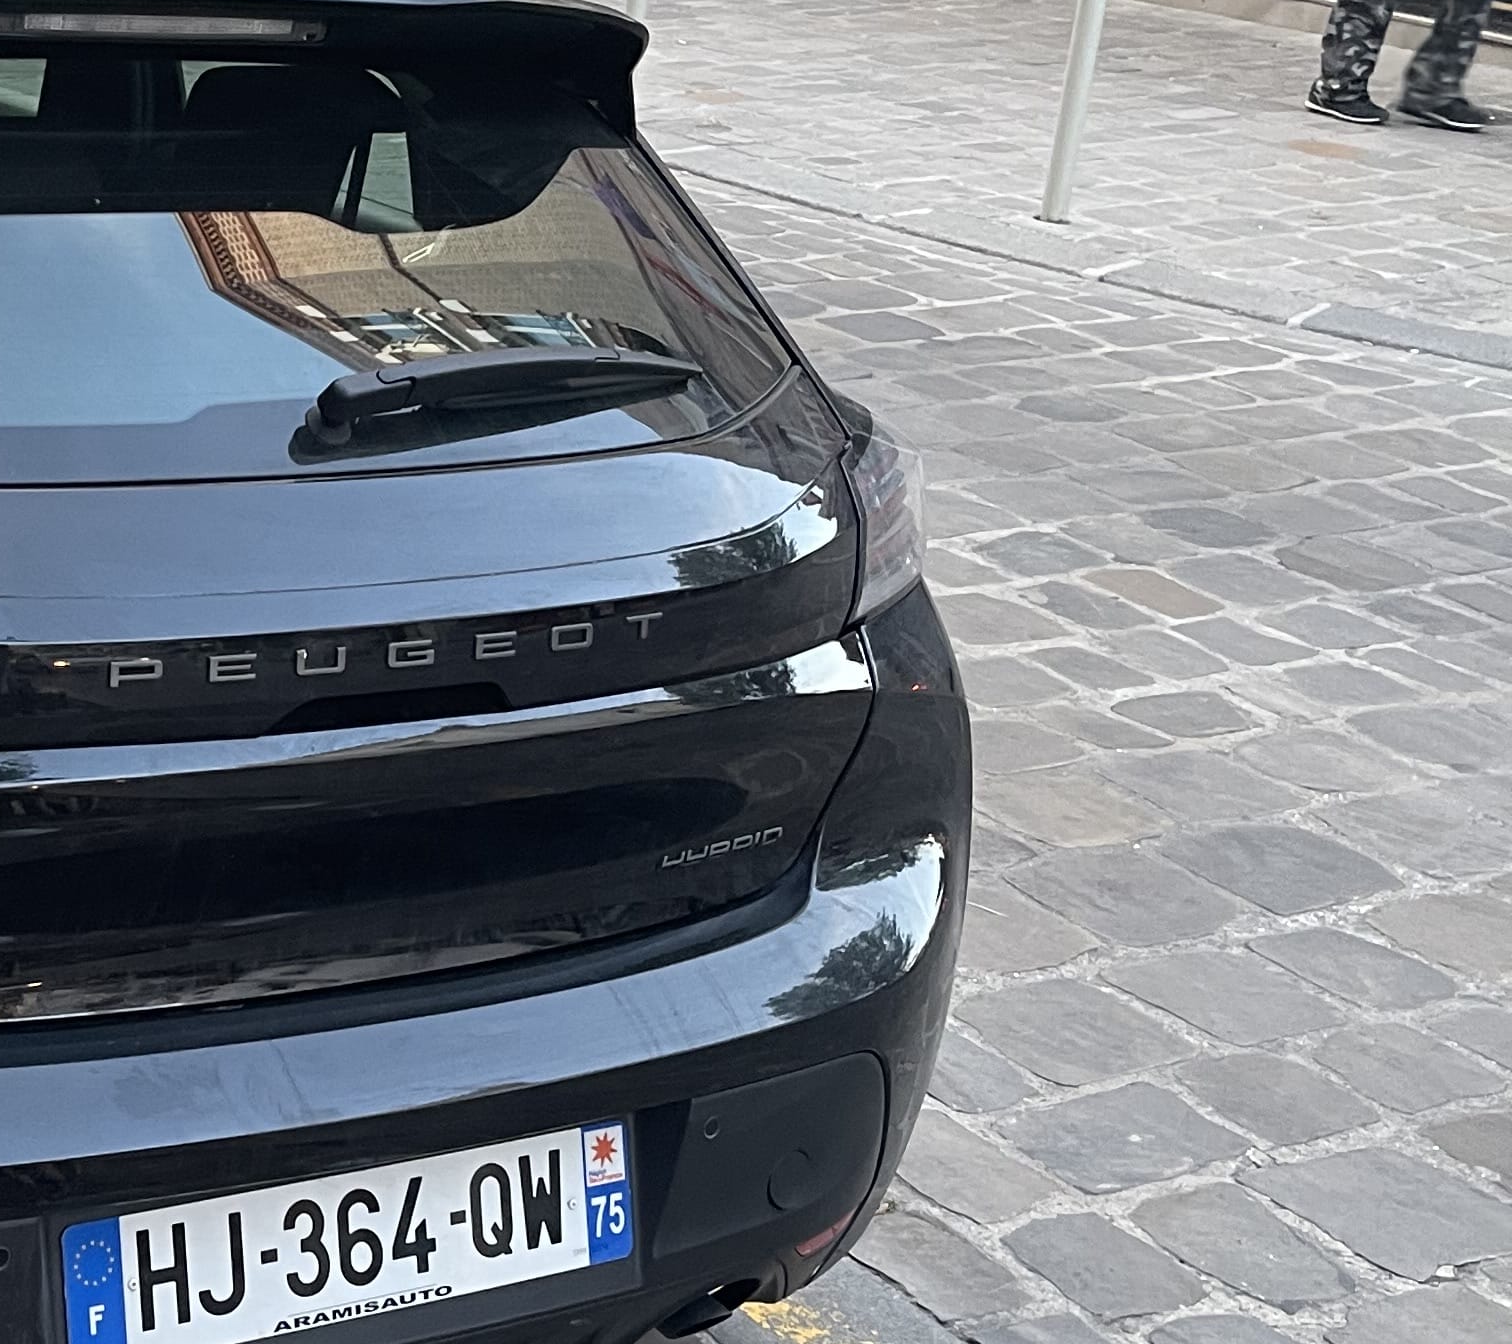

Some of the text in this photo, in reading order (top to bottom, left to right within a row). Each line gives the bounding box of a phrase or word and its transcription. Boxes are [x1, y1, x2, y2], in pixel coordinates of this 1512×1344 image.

[109, 611, 664, 689] PEUGEOT
[590, 1191, 626, 1238] 75
[135, 1148, 564, 1333] HJ-364-QW
[88, 1304, 106, 1336] F
[274, 1284, 453, 1333] ARAMISAUTO
